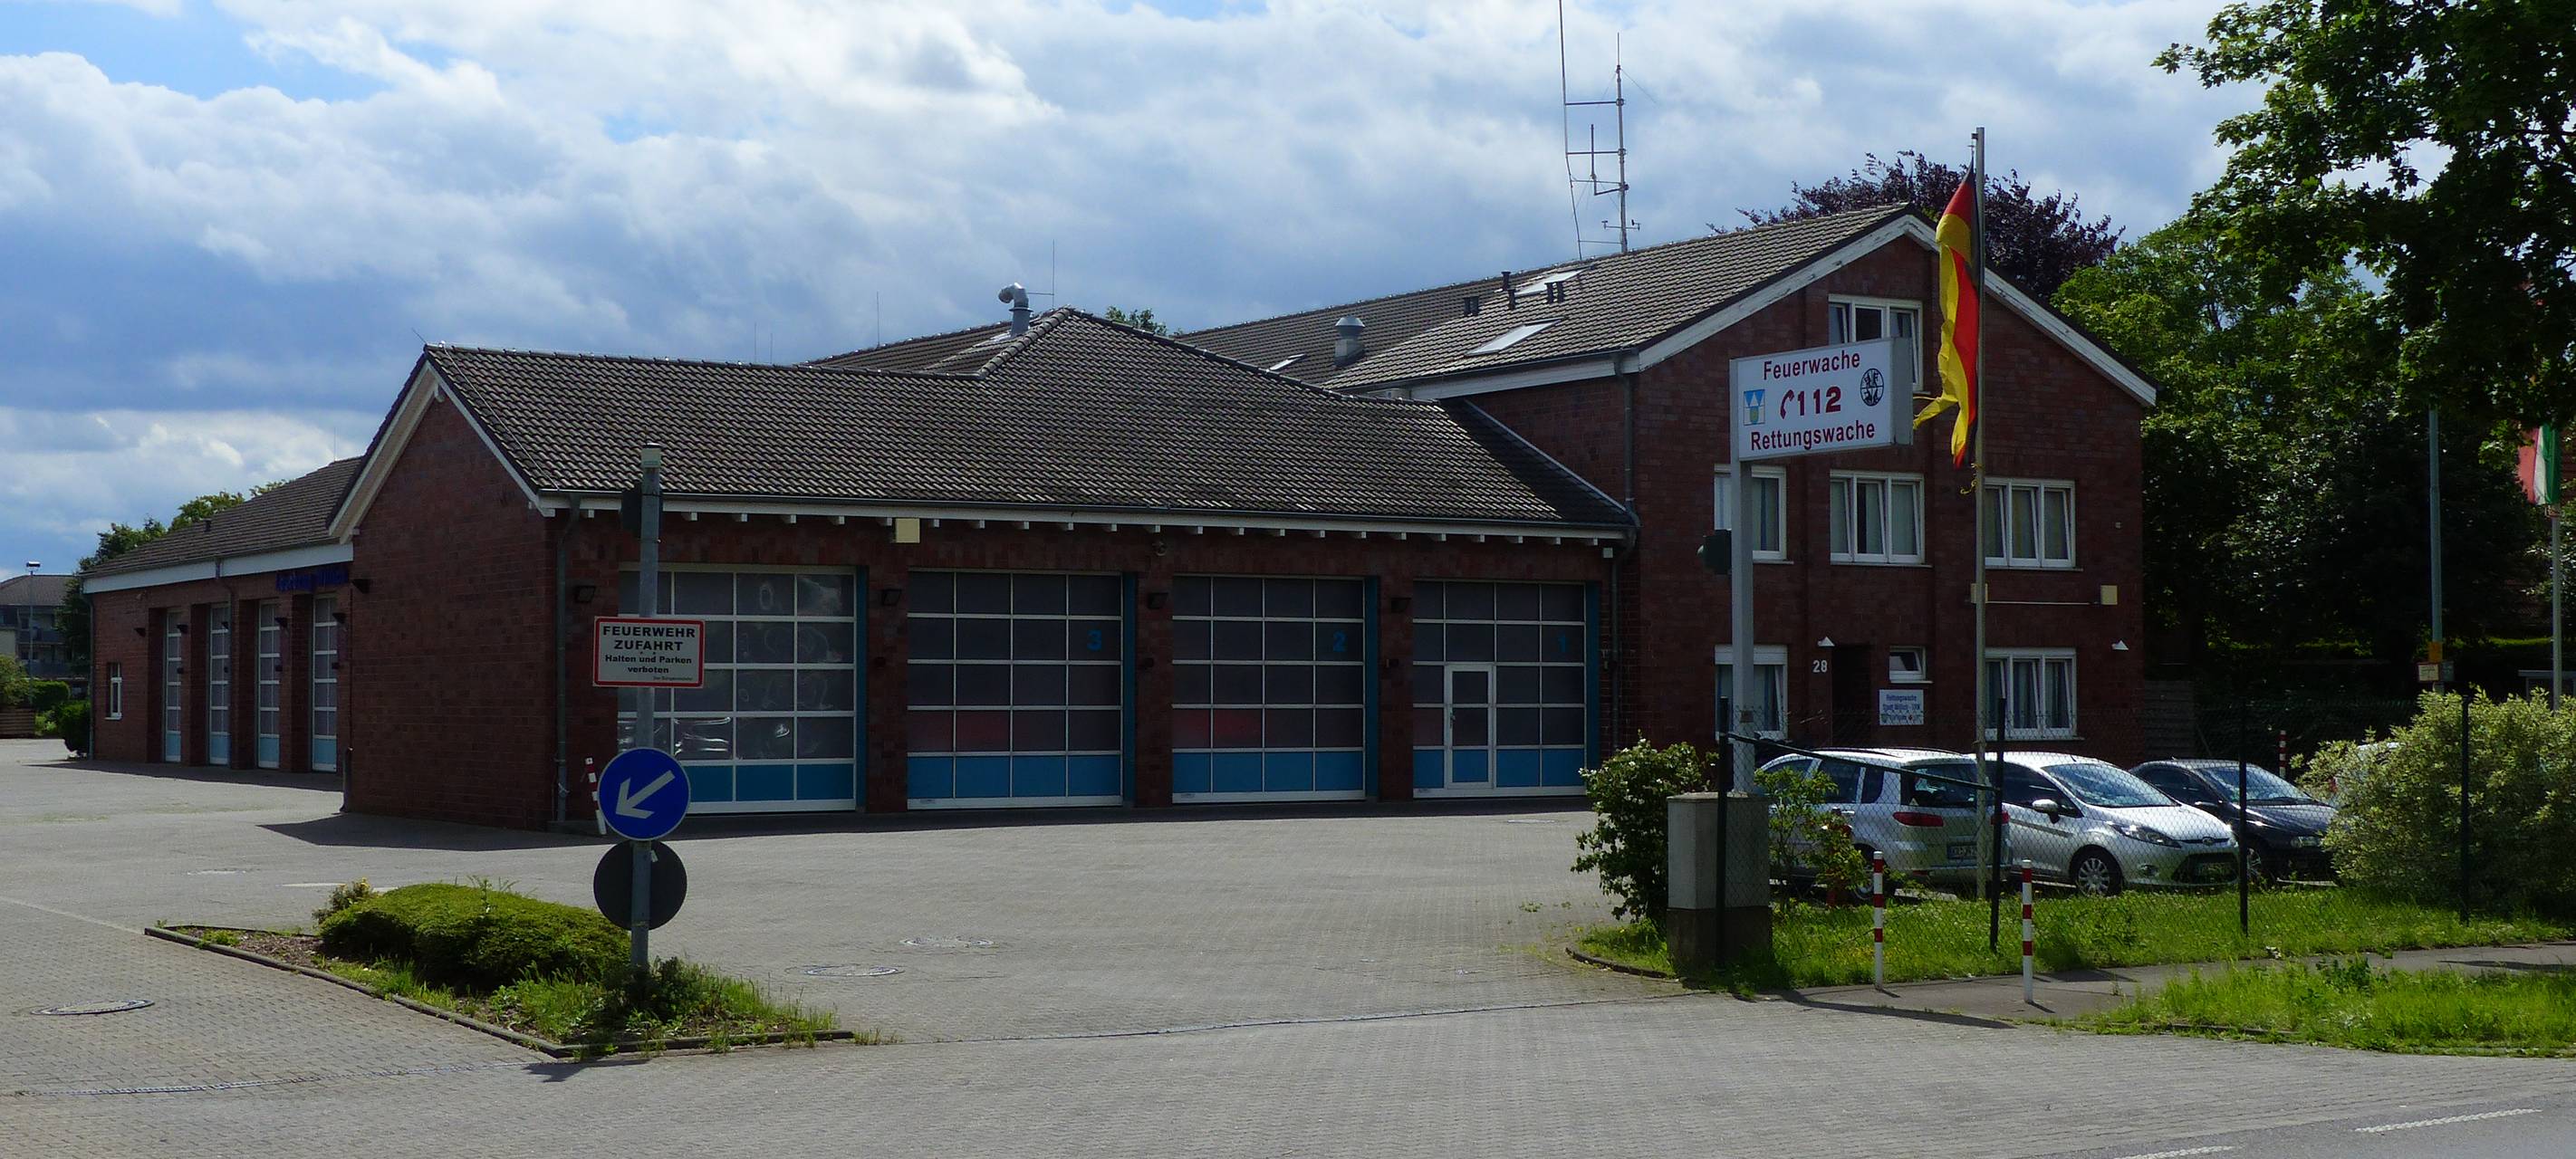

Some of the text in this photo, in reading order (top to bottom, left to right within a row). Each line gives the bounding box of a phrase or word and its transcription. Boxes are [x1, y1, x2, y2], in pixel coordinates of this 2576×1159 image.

[1764, 350, 1860, 380] Feuerwache
[1797, 386, 1841, 417] 112
[1751, 420, 1875, 451] Rettungswache
[603, 626, 696, 637] FEUERWEHR
[1087, 629, 1101, 651] 3
[614, 640, 684, 651] ZUFAHRT
[1333, 630, 1346, 652] 2
[605, 655, 692, 664] Halten und Parken
[1812, 659, 1828, 673] 28
[628, 666, 669, 674] verboten
